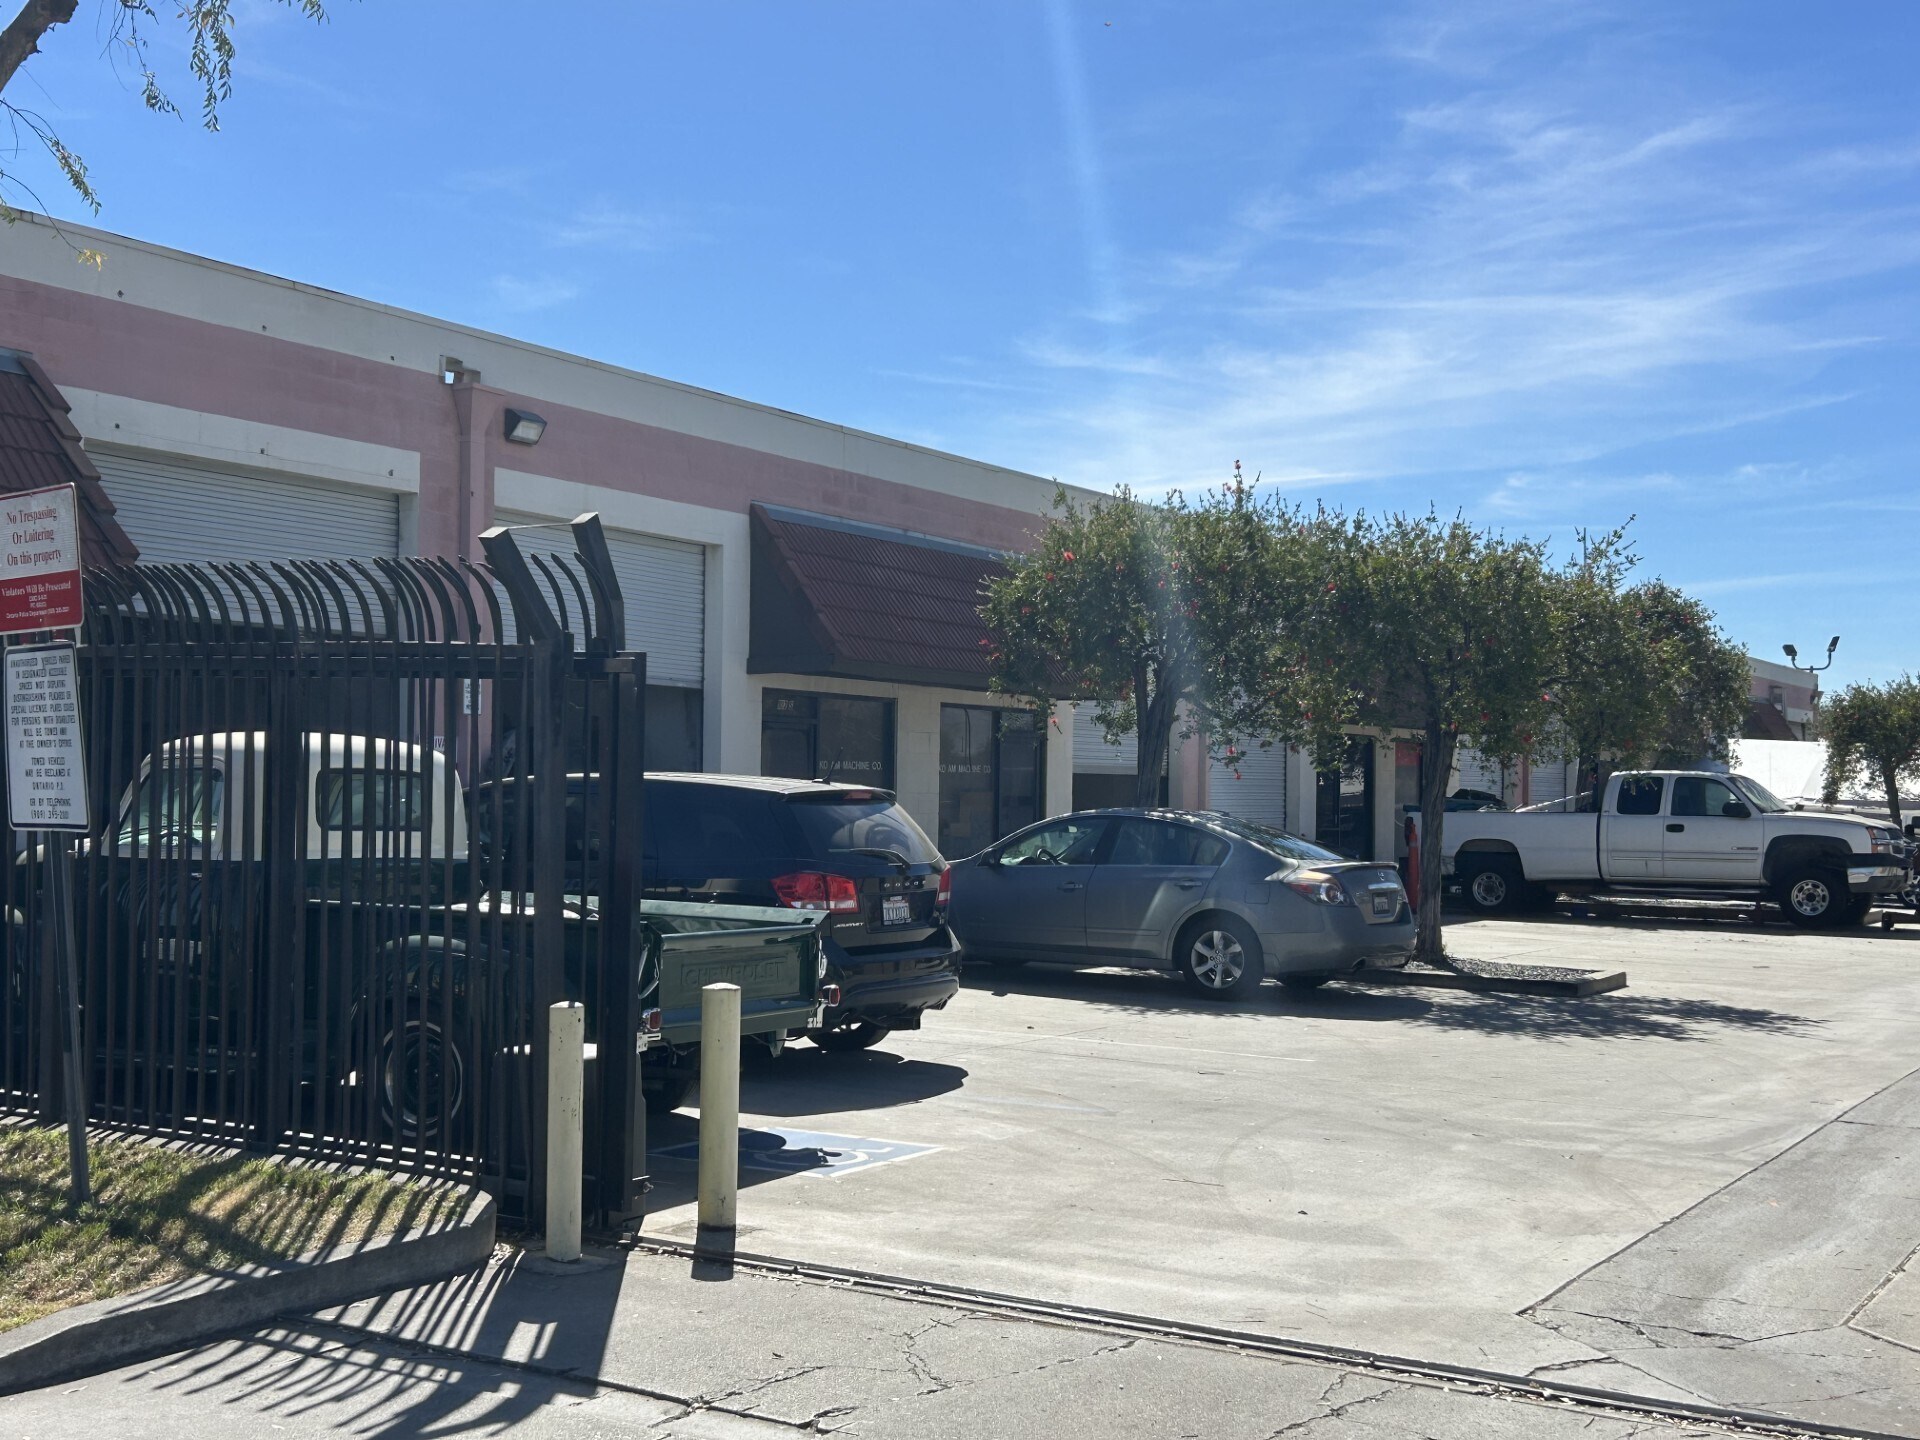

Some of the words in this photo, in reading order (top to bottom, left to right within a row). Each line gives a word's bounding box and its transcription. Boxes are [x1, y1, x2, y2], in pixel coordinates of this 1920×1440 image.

[7, 511, 17, 525] No
[18, 506, 57, 525] Trespassing
[12, 531, 23, 545] Or
[24, 528, 55, 544] Loitering
[7, 553, 19, 567] On
[20, 551, 32, 565] this
[33, 549, 62, 567] property
[1, 587, 26, 597] Violators
[26, 583, 38, 594] Will
[38, 583, 45, 592] Be
[45, 580, 71, 592] Prosecuted
[35, 680, 45, 689] NOT
[28, 704, 48, 713] LICENSE
[21, 716, 41, 726] PERSONS
[43, 715, 54, 724] WITH
[23, 728, 34, 737] WILL
[35, 727, 43, 737] BE
[44, 727, 58, 736] TOWED
[26, 739, 35, 749] THE
[31, 756, 45, 766] TOWED
[842, 760, 870, 770] MACHINE
[36, 768, 43, 778] BE
[32, 781, 55, 791] ONTARIO
[29, 797, 36, 807] OR
[38, 797, 45, 807] BY
[685, 961, 783, 985] CHEVROLET
